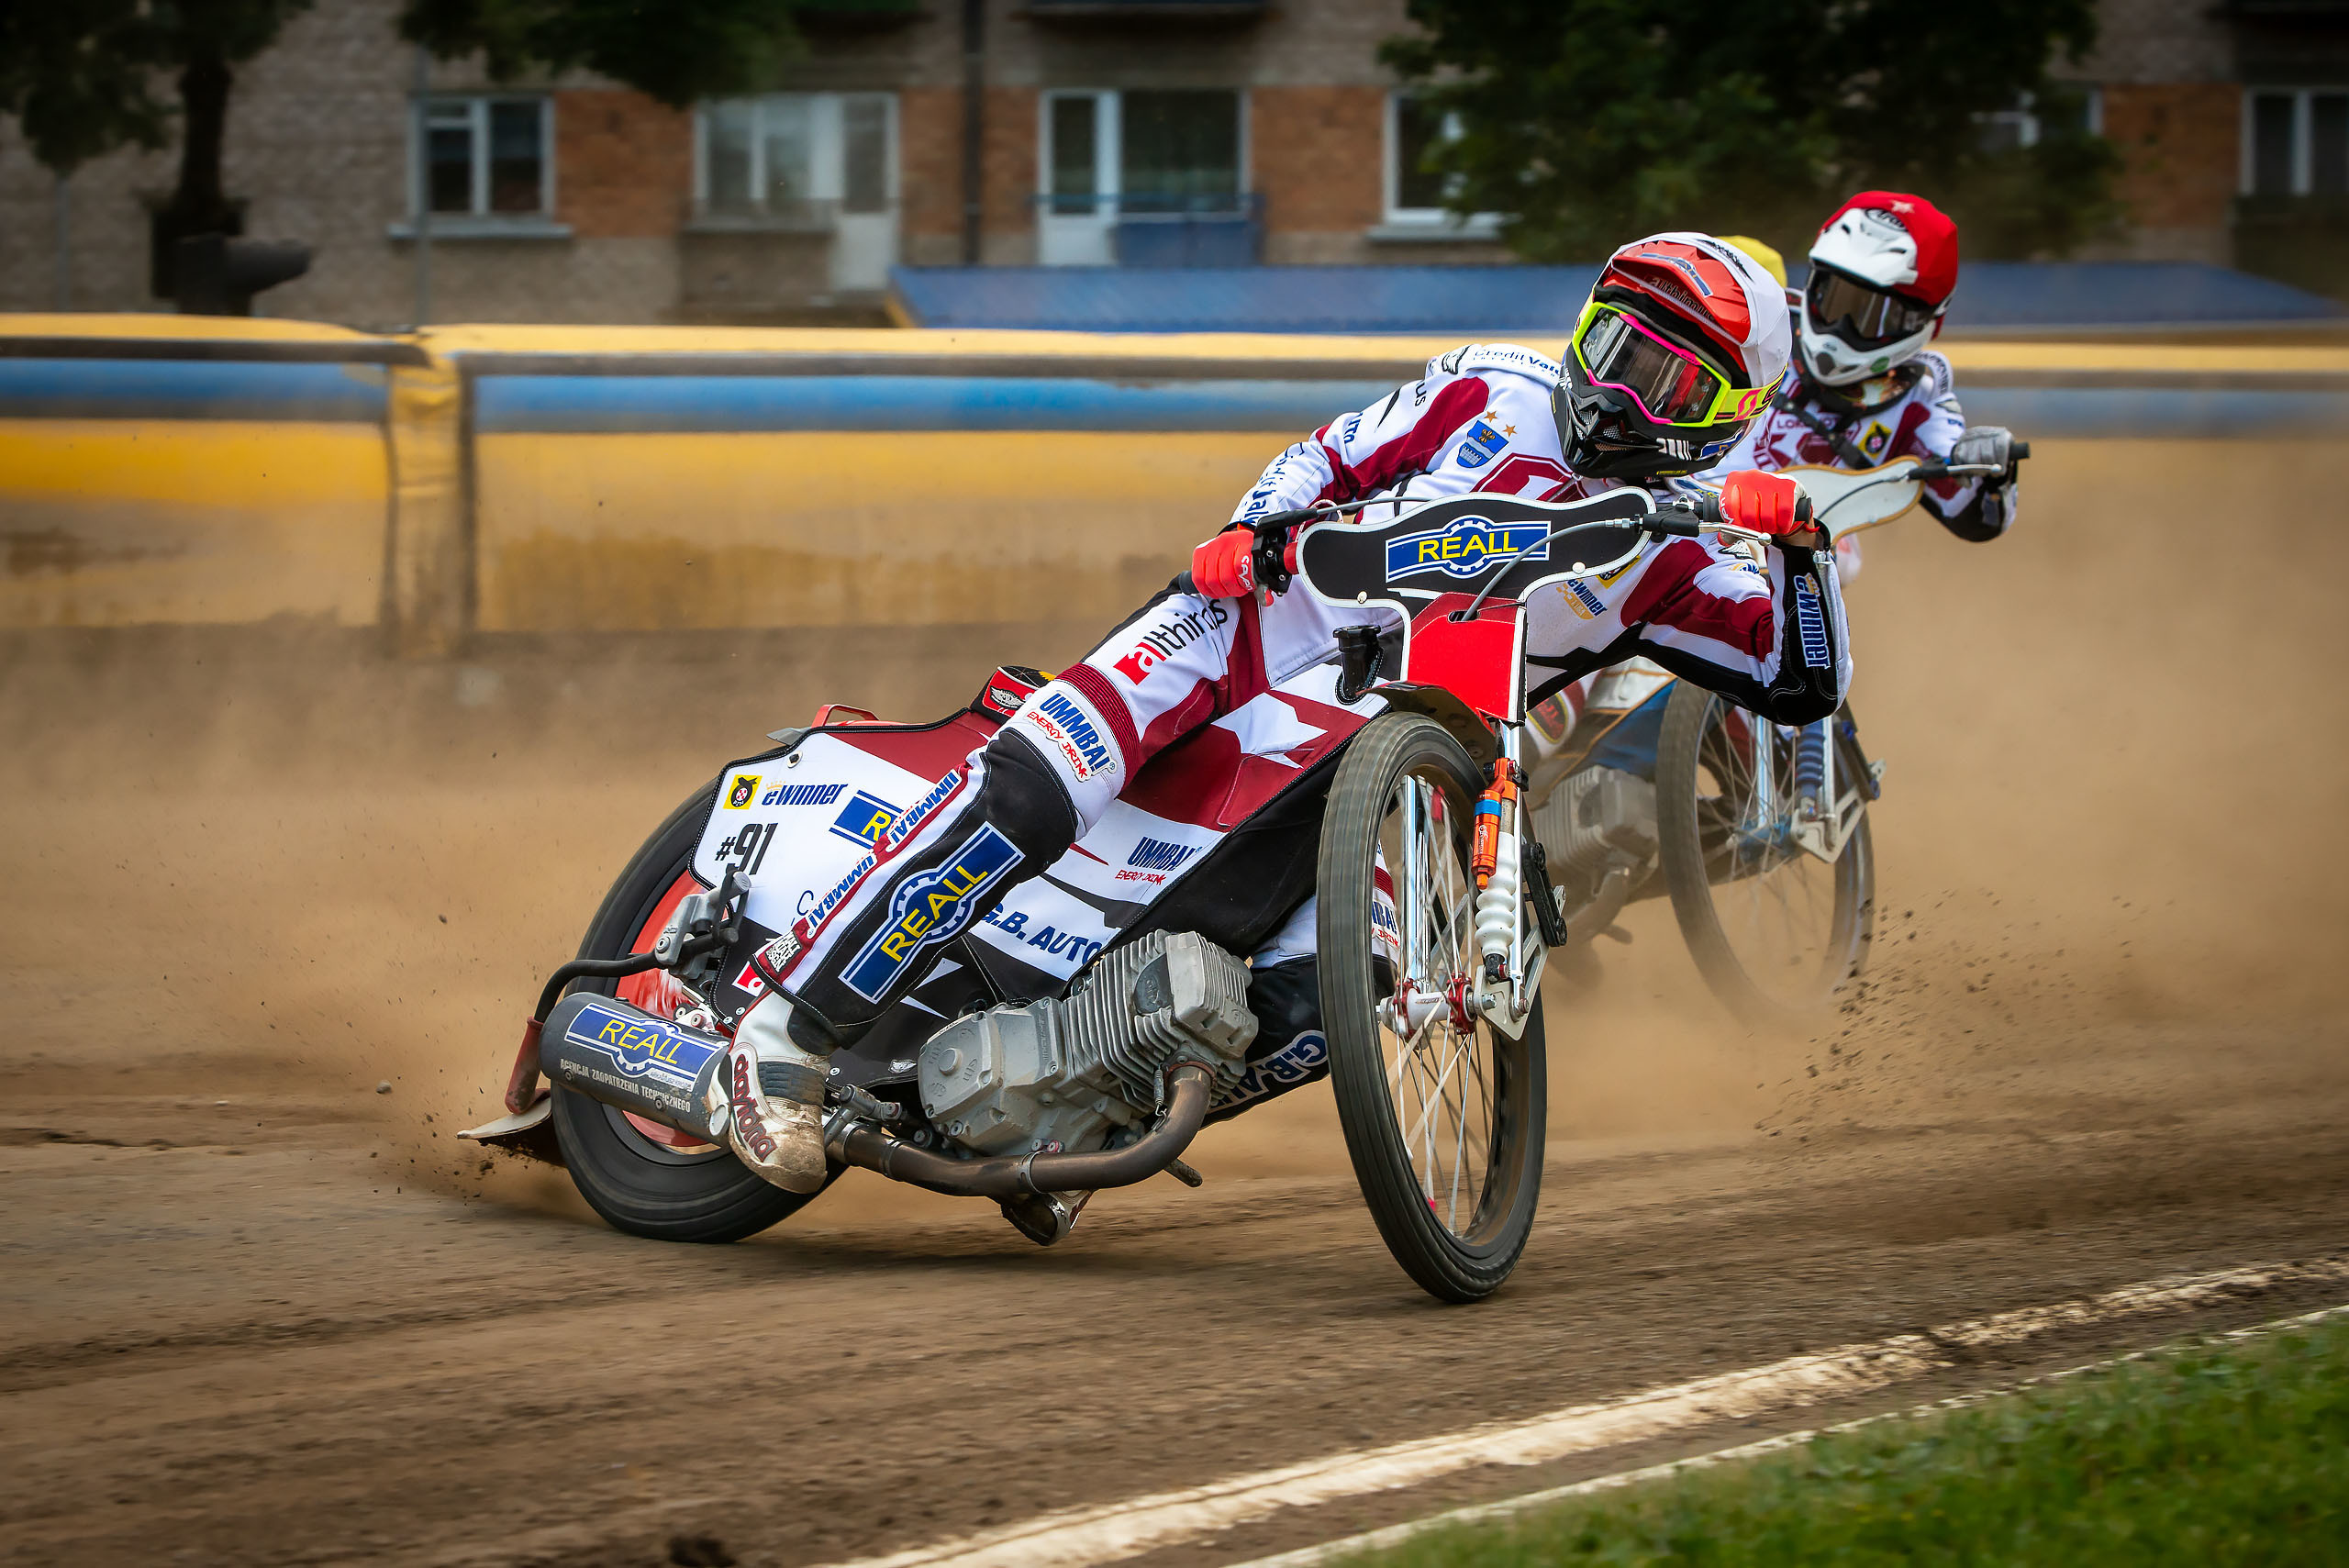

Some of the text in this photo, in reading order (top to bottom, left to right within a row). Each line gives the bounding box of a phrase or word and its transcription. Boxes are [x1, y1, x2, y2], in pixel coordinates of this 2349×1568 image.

[1419, 531, 1519, 562] REALL
[1027, 711, 1088, 779] ENERGY DRINK
[1040, 693, 1110, 773] UMMBA!
[762, 784, 849, 806] eWinner
[881, 865, 988, 962] REALL
[598, 1019, 683, 1064] REALL
[592, 1069, 640, 1095] ZAOPATRZENIA
[732, 1053, 778, 1162] daytona
